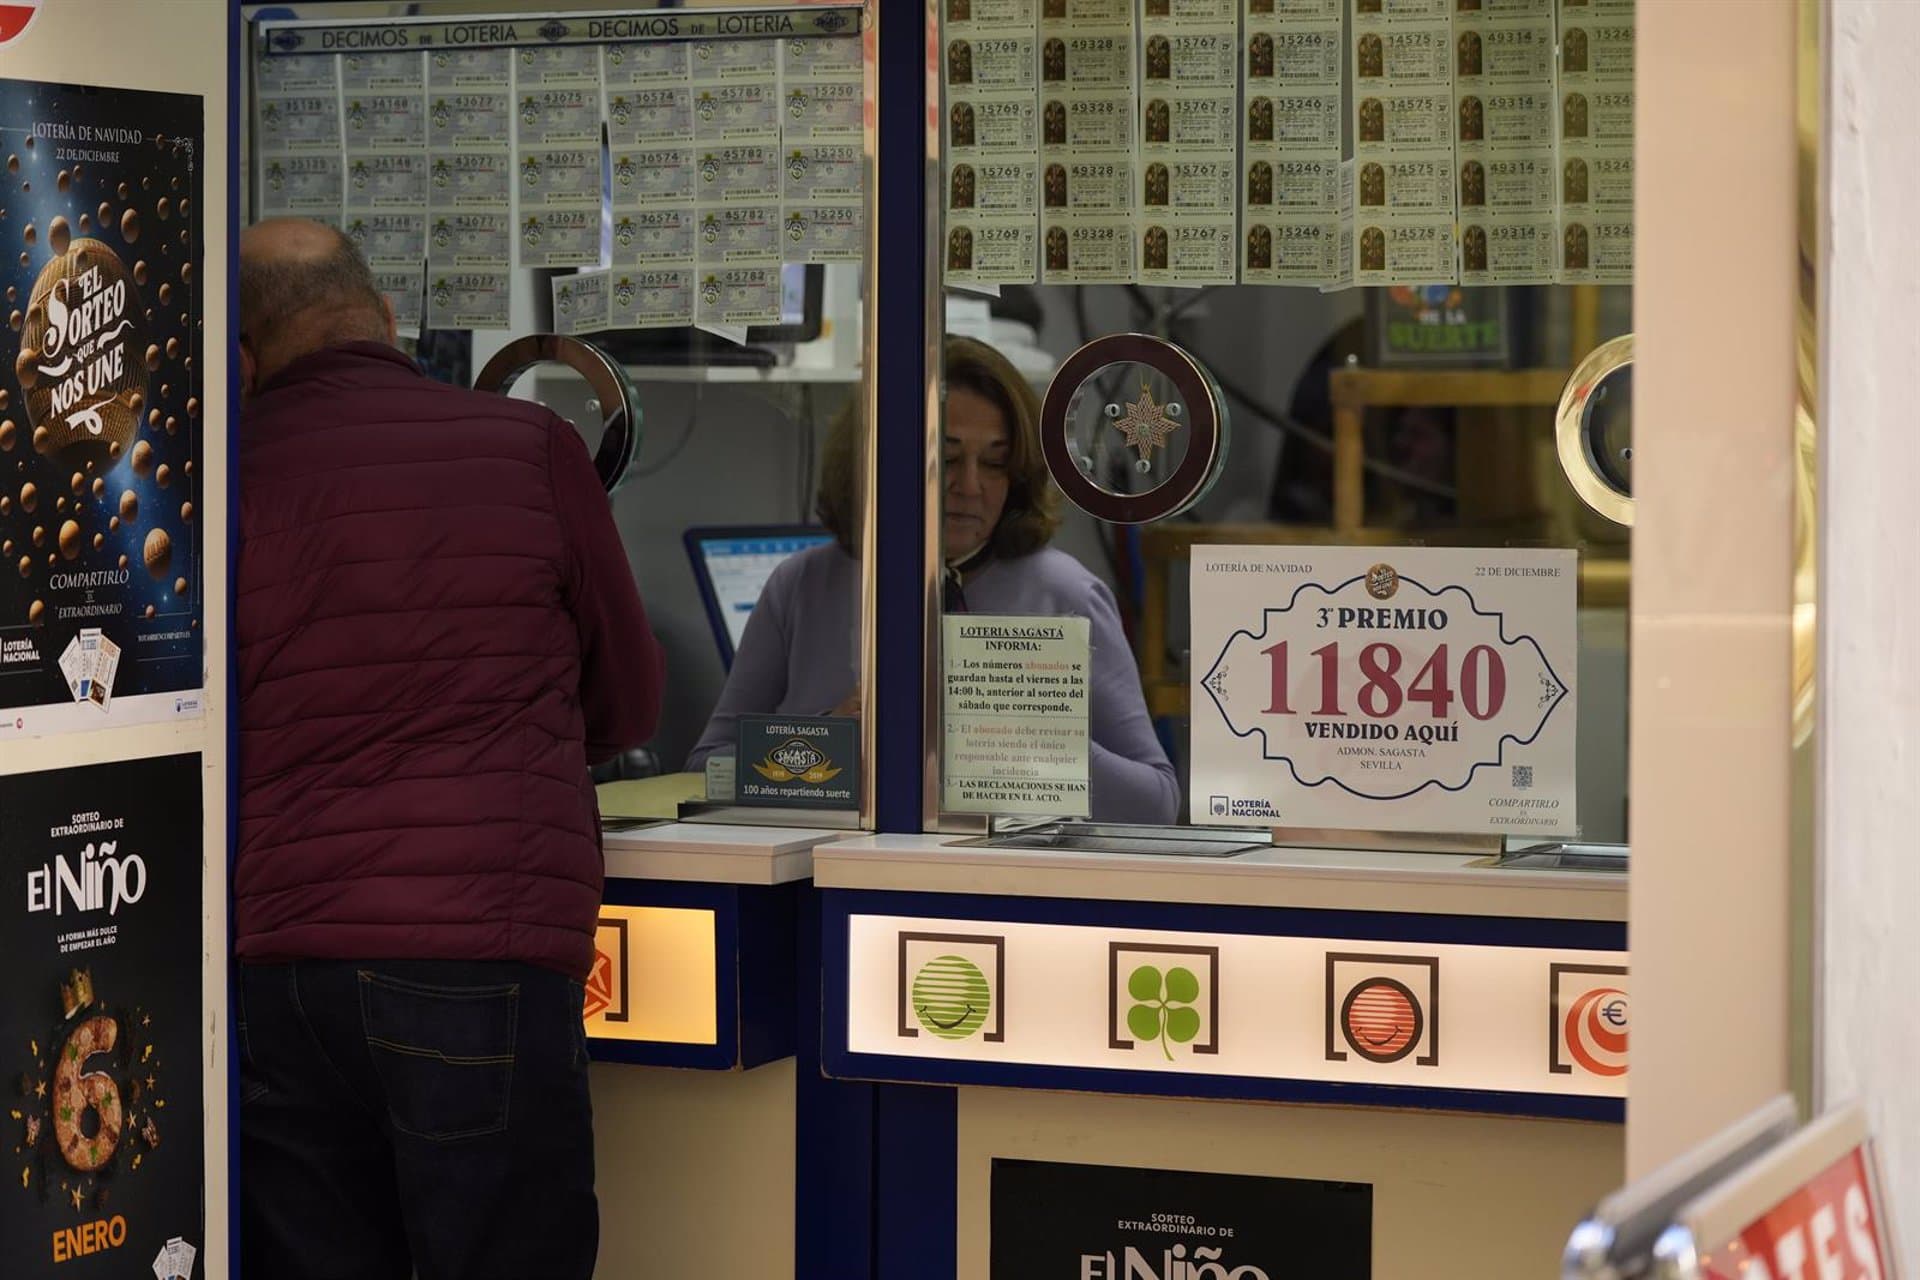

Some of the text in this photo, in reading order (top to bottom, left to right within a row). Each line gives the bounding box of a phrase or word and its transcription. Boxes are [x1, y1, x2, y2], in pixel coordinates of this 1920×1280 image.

[589, 18, 679, 38] DECIMOS
[691, 24, 704, 34] DE
[717, 16, 793, 34] LOTERIA
[322, 29, 408, 48] DECIMOS
[444, 25, 518, 42] LOTERIA
[1175, 37, 1217, 48] 15767
[1280, 35, 1322, 45] 15246
[1389, 34, 1431, 45] 14575
[1488, 31, 1532, 43] 49314
[977, 41, 1018, 53] 15769
[1071, 39, 1113, 50] 49328
[1071, 102, 1114, 113] 49328
[1175, 100, 1218, 112] 15767
[1279, 99, 1322, 109] 15246
[1389, 98, 1433, 109] 14575
[1488, 97, 1533, 108] 49314
[979, 103, 1020, 115] 15769
[32, 120, 142, 145] LOTERÍA DE NAVIDAD
[56, 148, 66, 160] 22
[78, 150, 120, 163] DICIEMBRE
[980, 166, 1021, 177] 15769
[1072, 165, 1114, 177] 49328
[1175, 165, 1217, 176] 15767
[1279, 163, 1321, 173] 15246
[1391, 164, 1434, 174] 14575
[1490, 162, 1535, 173] 49314
[979, 229, 1020, 239] 15769
[1073, 228, 1115, 240] 49328
[1175, 228, 1216, 239] 15767
[1277, 227, 1320, 237] 15246
[1392, 228, 1435, 239] 14575
[1490, 227, 1536, 238] 49314
[78, 265, 102, 299] EL
[73, 339, 95, 363] QUE
[51, 342, 124, 419] NOS UNE
[1205, 562, 1313, 575] LOTERÍA DE NAVIDAD
[1474, 567, 1561, 578] 22 DE DICIEMBRE
[50, 568, 129, 590] COMPARTIRLO
[59, 603, 123, 619] EXTRAORDINARIO
[1338, 607, 1448, 631] PREMIO
[3, 637, 33, 652] LOTERÍA
[985, 640, 1042, 651] INFORMA:
[3, 650, 40, 663] NACIONAL
[963, 659, 980, 669] Los
[982, 658, 1023, 670] números
[1071, 664, 1082, 672] se
[948, 673, 1084, 686] guardan hasta el viernes a las
[1260, 640, 1506, 721] 11840
[948, 686, 1084, 699] 14:00 h, anterior al sorteo del
[958, 700, 1073, 714] sábado que corresponde.
[766, 725, 829, 736] LOTERÍA SAGASTA
[961, 724, 972, 734] El
[973, 724, 1013, 735] abonado
[1014, 725, 1037, 736] debe
[1039, 726, 1072, 737] revisar
[1074, 729, 1085, 737] su
[1305, 721, 1459, 745] VENDIDO AQUÍ
[998, 739, 1027, 749] siendo
[1040, 739, 1066, 750] único
[778, 749, 816, 766] SAGASTA
[1336, 746, 1426, 758] ADMON. SAGASTA
[954, 752, 1078, 765] responsable ante cualquier
[992, 765, 1040, 776] incidencia
[1360, 760, 1403, 771] SEVILLA
[743, 784, 851, 799] 100 años repartiendo suerte
[959, 780, 1086, 792] LAS RECLAMACIONES SE HAN
[962, 791, 1062, 802] DE HACER EN EL ACTO.
[1231, 798, 1271, 808] LOTERÍA
[1488, 798, 1560, 809] COMPARTIRLO
[72, 811, 100, 824] SORTEO
[1231, 808, 1281, 818] NACIONAL
[1488, 816, 1559, 826] EXTRAORDINARIO
[51, 818, 124, 838] EXTRAORDINARIO DE
[55, 840, 147, 916] Niño
[57, 934, 65, 943] LA
[66, 930, 86, 942] FORMA
[100, 925, 118, 936] DULCE
[60, 935, 116, 953] DE EMPEZAR EL AÑO
[1151, 1213, 1195, 1225] SORTEO
[1117, 1220, 1234, 1238] EXTRAORDINARIO DE
[53, 1214, 128, 1264] ENERO
